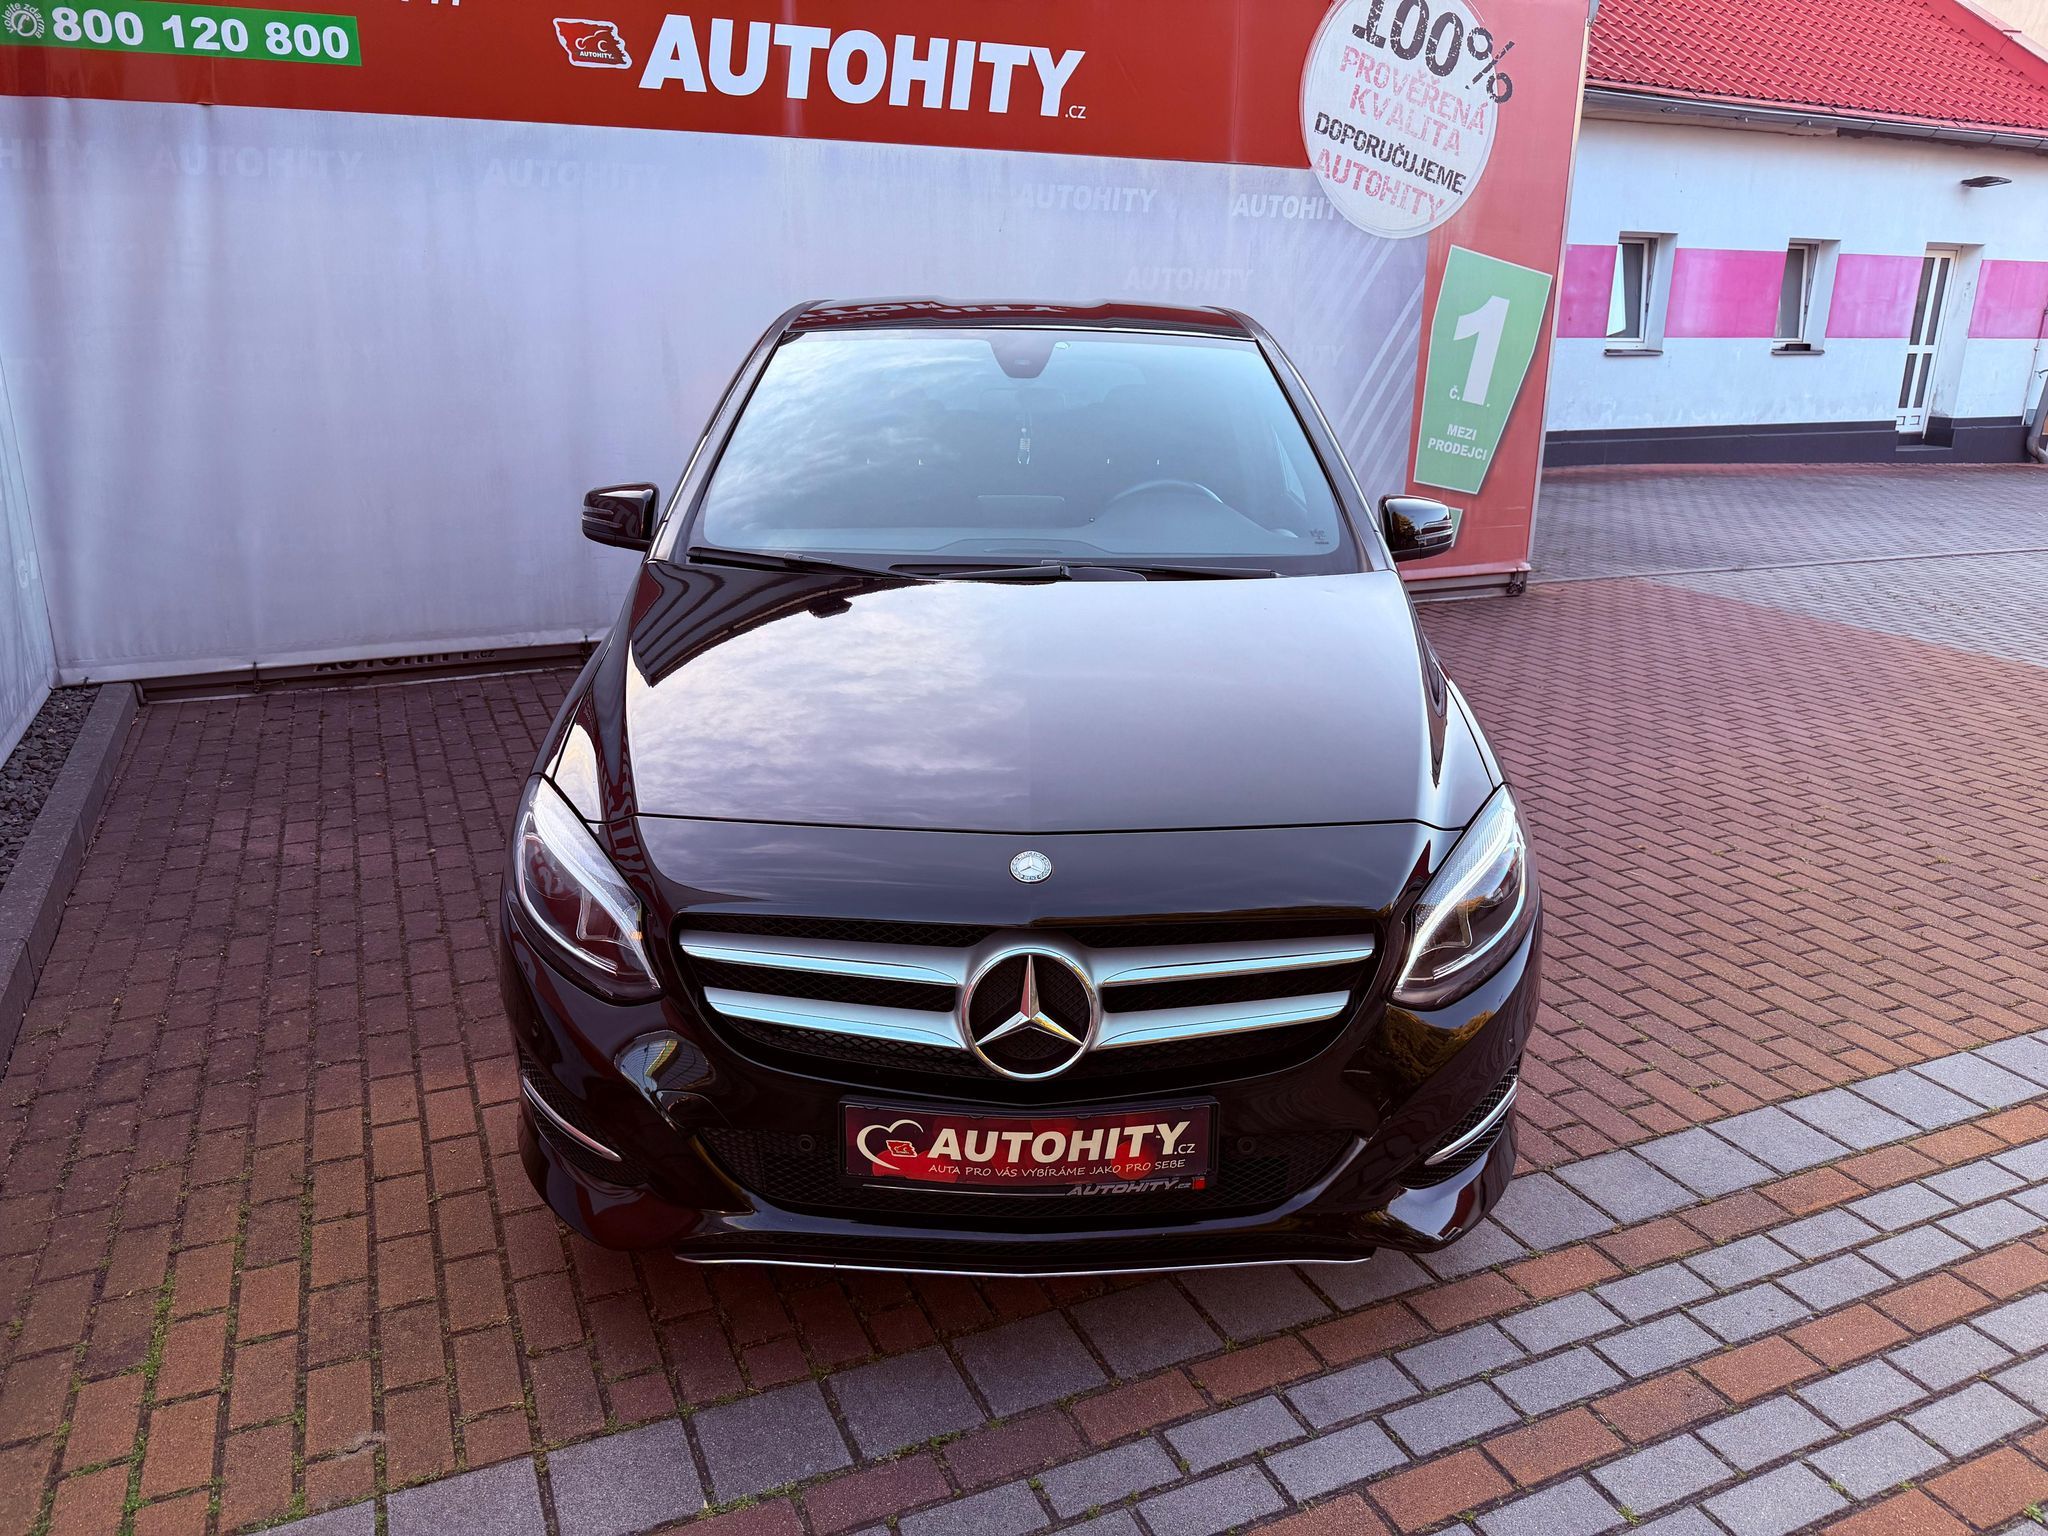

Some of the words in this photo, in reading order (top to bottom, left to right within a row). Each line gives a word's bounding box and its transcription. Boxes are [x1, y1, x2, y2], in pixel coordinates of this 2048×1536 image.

[23, 3, 45, 39] zdarma
[52, 6, 144, 46] 800
[162, 14, 249, 53] 120
[264, 21, 349, 59] 800
[1352, 0, 1514, 104] 100%
[1339, 45, 1489, 136] PROVĚŘENÁ
[1349, 84, 1461, 157] KVALITA
[1314, 111, 1467, 196] DOPORUČUJEME
[1020, 184, 1158, 214] AUTOHITY
[1315, 148, 1445, 222] AUTOHITY
[1427, 438, 1487, 461] PRODEJCI
[1447, 423, 1477, 441] MEZI
[928, 1164, 960, 1175] AUTA
[965, 1166, 991, 1177] PRO
[995, 1165, 1018, 1178] VÁS
[1020, 1163, 1085, 1178] VYBÍRÁME
[1089, 1164, 1120, 1176] JAKO
[1125, 1161, 1151, 1173] PRO
[1154, 1158, 1185, 1170] SEBE
